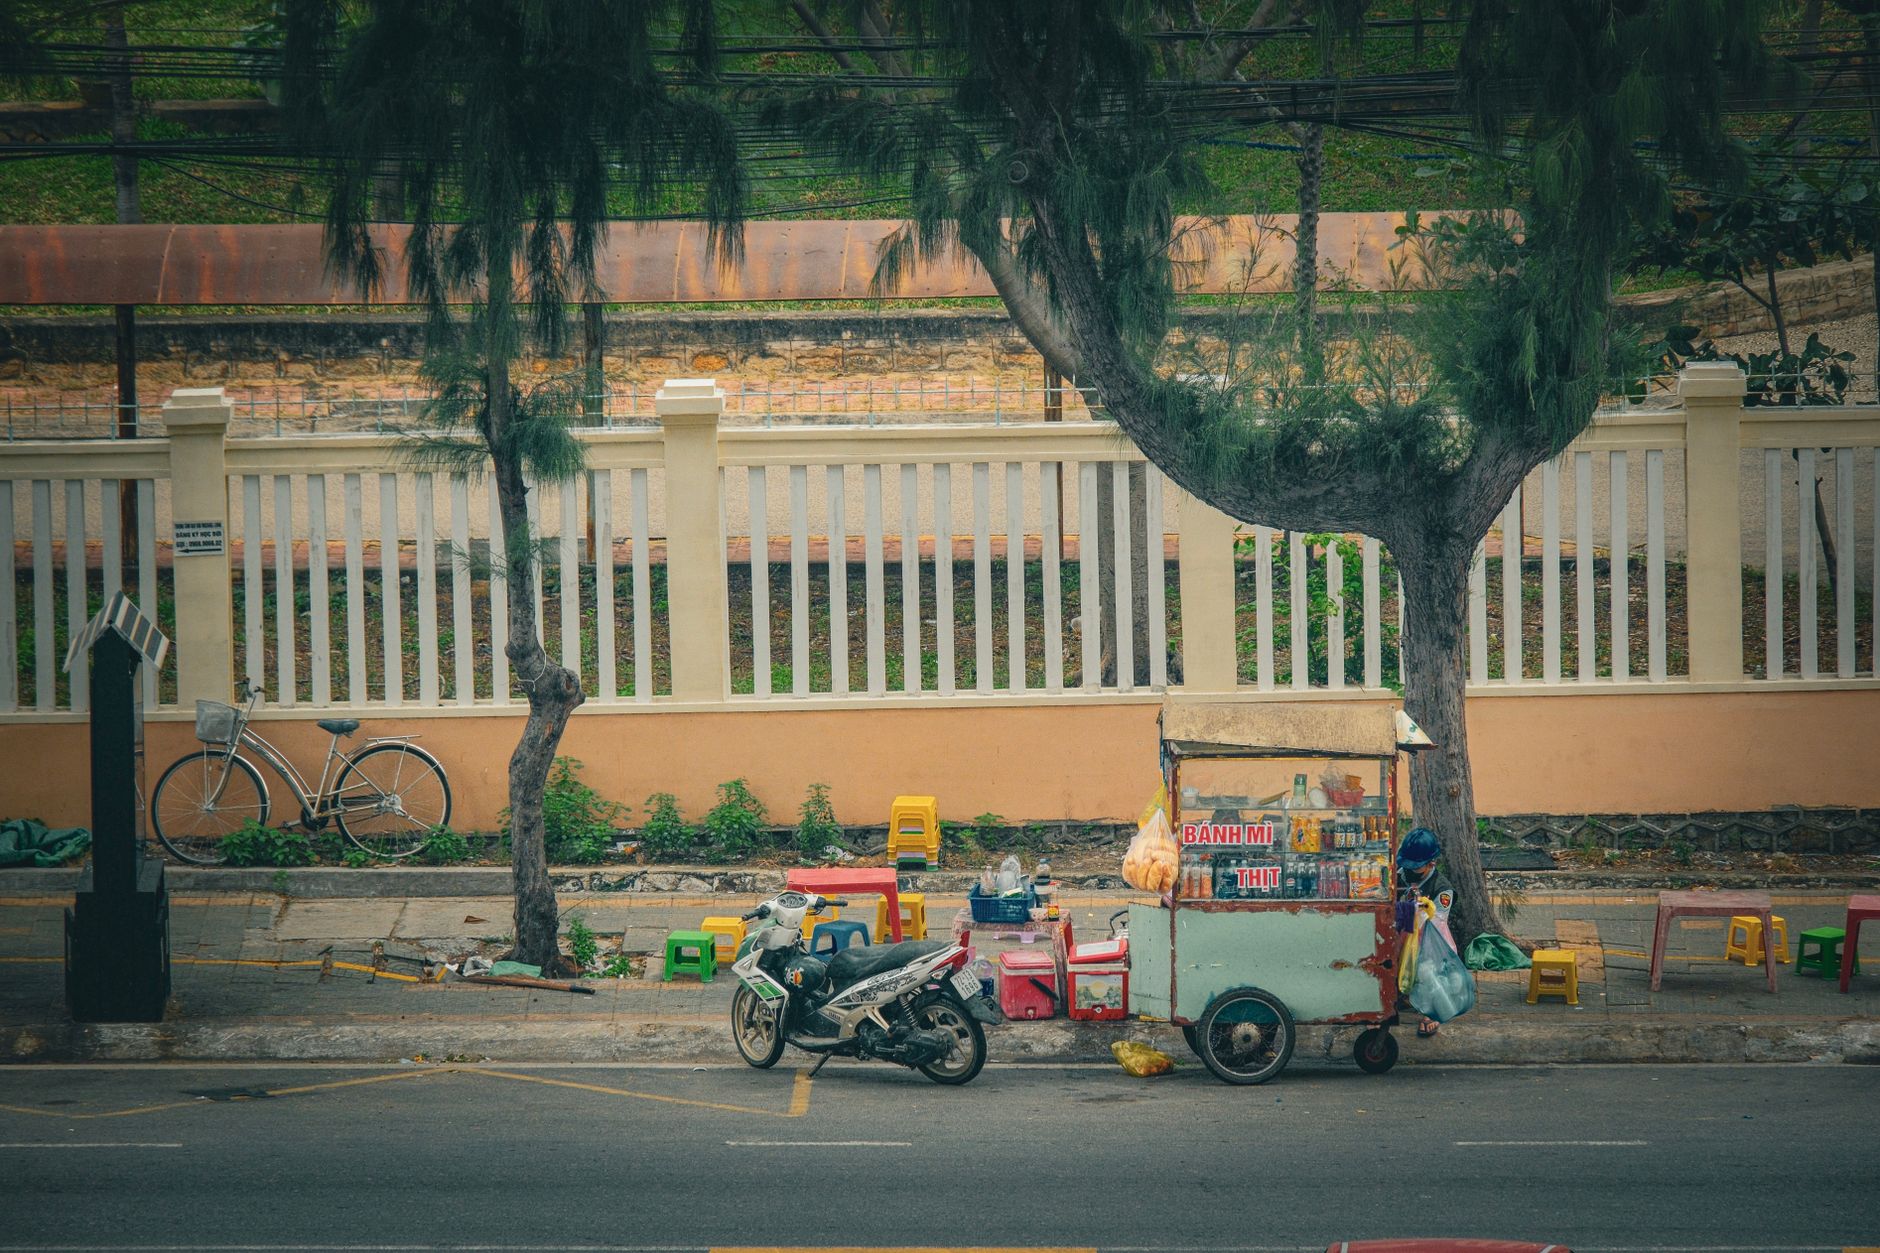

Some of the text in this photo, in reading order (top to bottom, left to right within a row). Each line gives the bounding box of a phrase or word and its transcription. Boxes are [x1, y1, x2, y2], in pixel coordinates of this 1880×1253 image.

[1183, 820, 1243, 845] BÁNH
[1245, 820, 1273, 845] MÌ
[1235, 866, 1281, 892] THỊT
